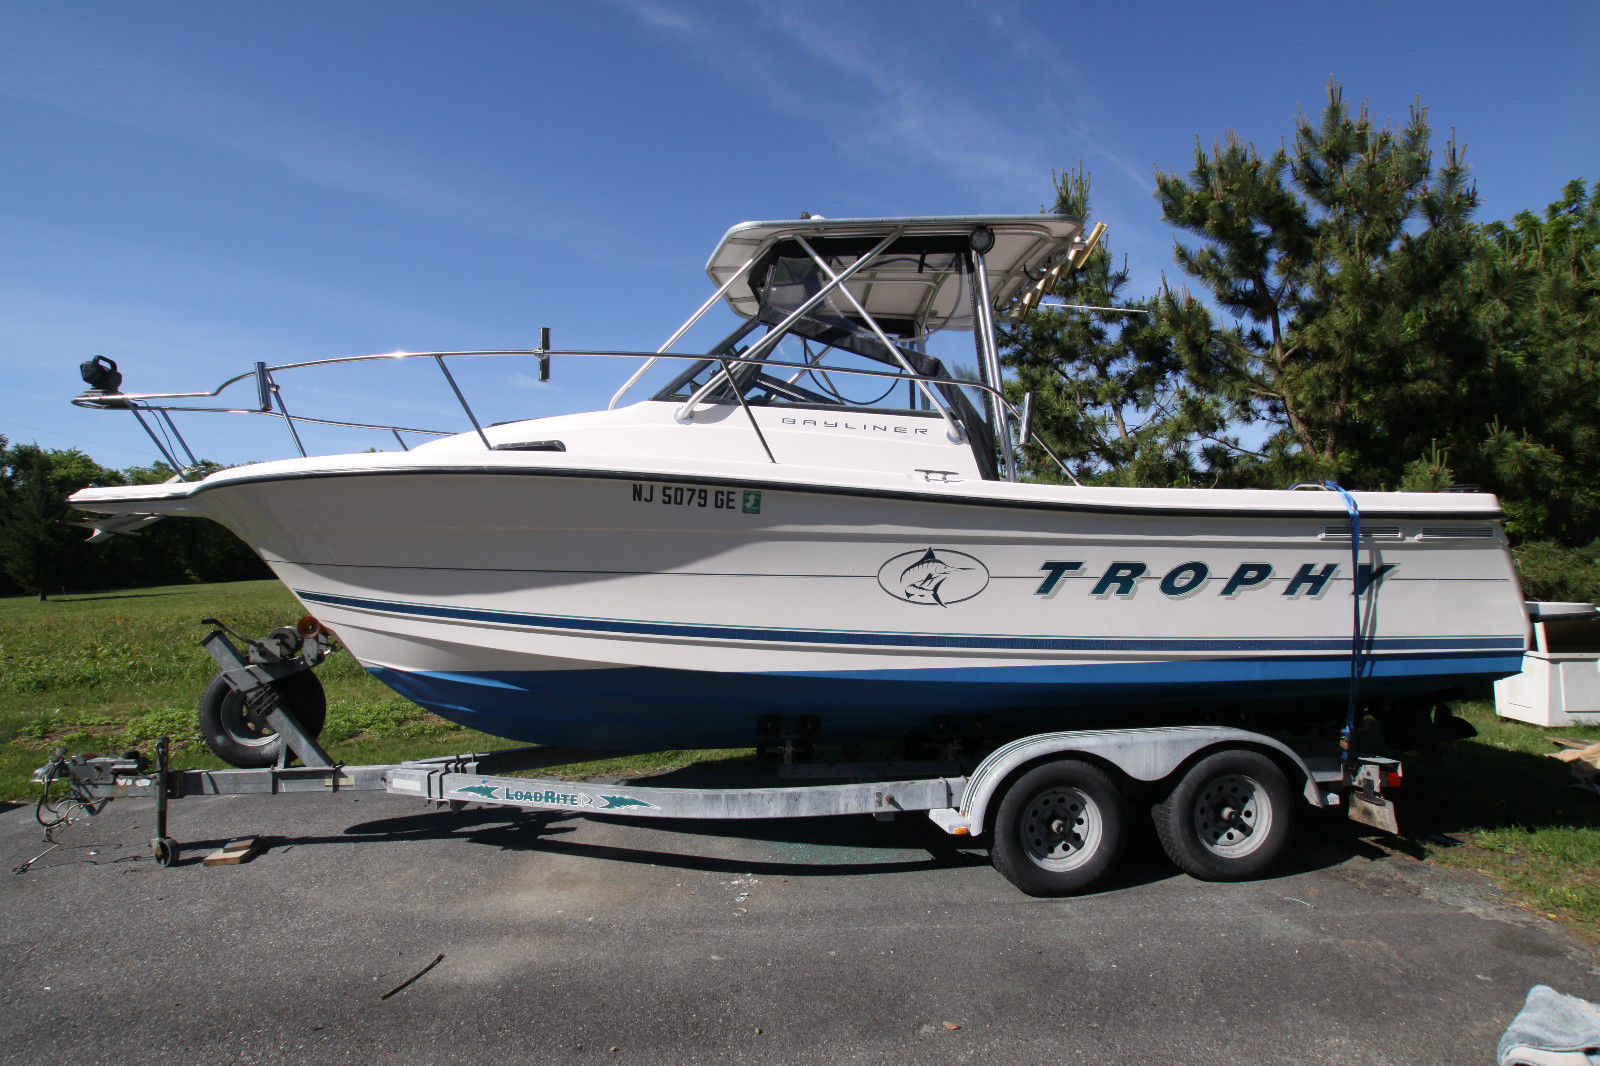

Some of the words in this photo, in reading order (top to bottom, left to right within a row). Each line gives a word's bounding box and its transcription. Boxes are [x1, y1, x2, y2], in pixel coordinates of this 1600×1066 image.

[781, 417, 929, 436] BAYLINER
[632, 483, 654, 503] NJ
[661, 486, 708, 508] 5079
[714, 490, 737, 510] GE
[1033, 561, 1401, 600] TROPHY
